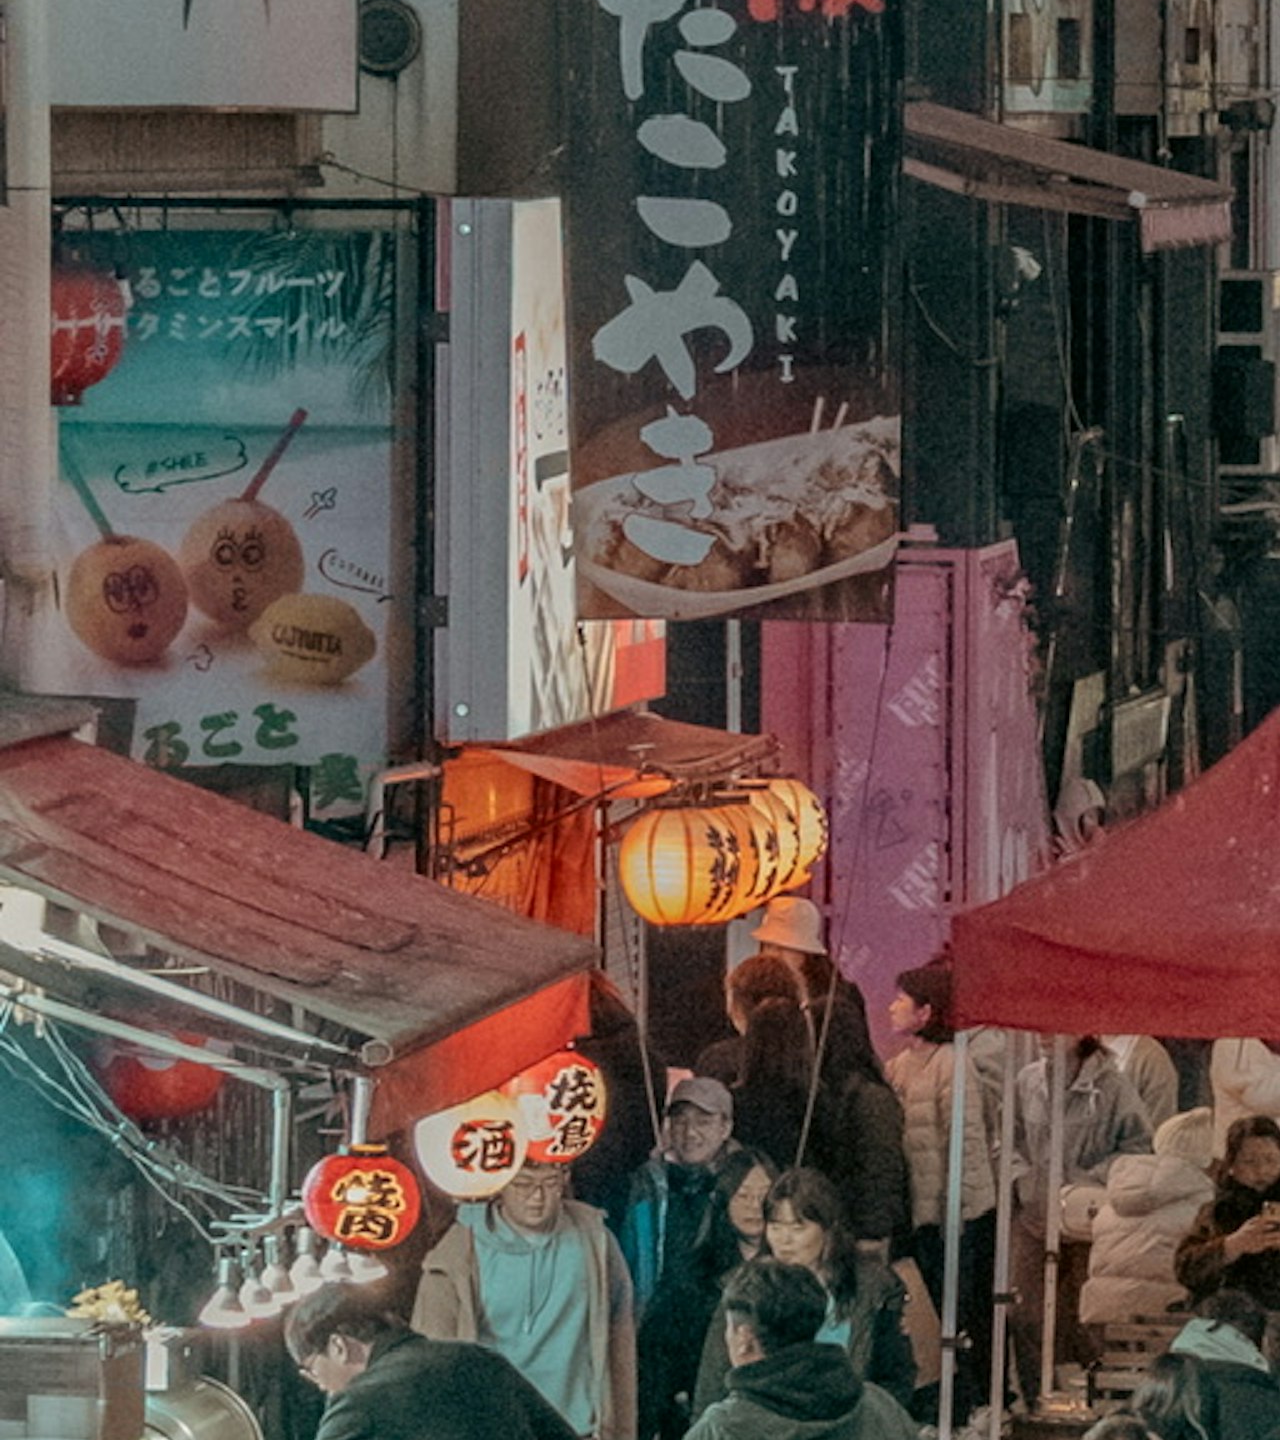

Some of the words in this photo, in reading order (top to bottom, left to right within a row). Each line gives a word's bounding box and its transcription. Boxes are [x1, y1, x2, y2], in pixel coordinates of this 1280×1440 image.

[774, 65, 800, 384] TAKOYAKI
[121, 268, 346, 299] るごとフルーツ
[453, 1120, 516, 1171] 酒
[550, 1068, 598, 1154] 焼鳥
[333, 1171, 404, 1243] 焼肉
